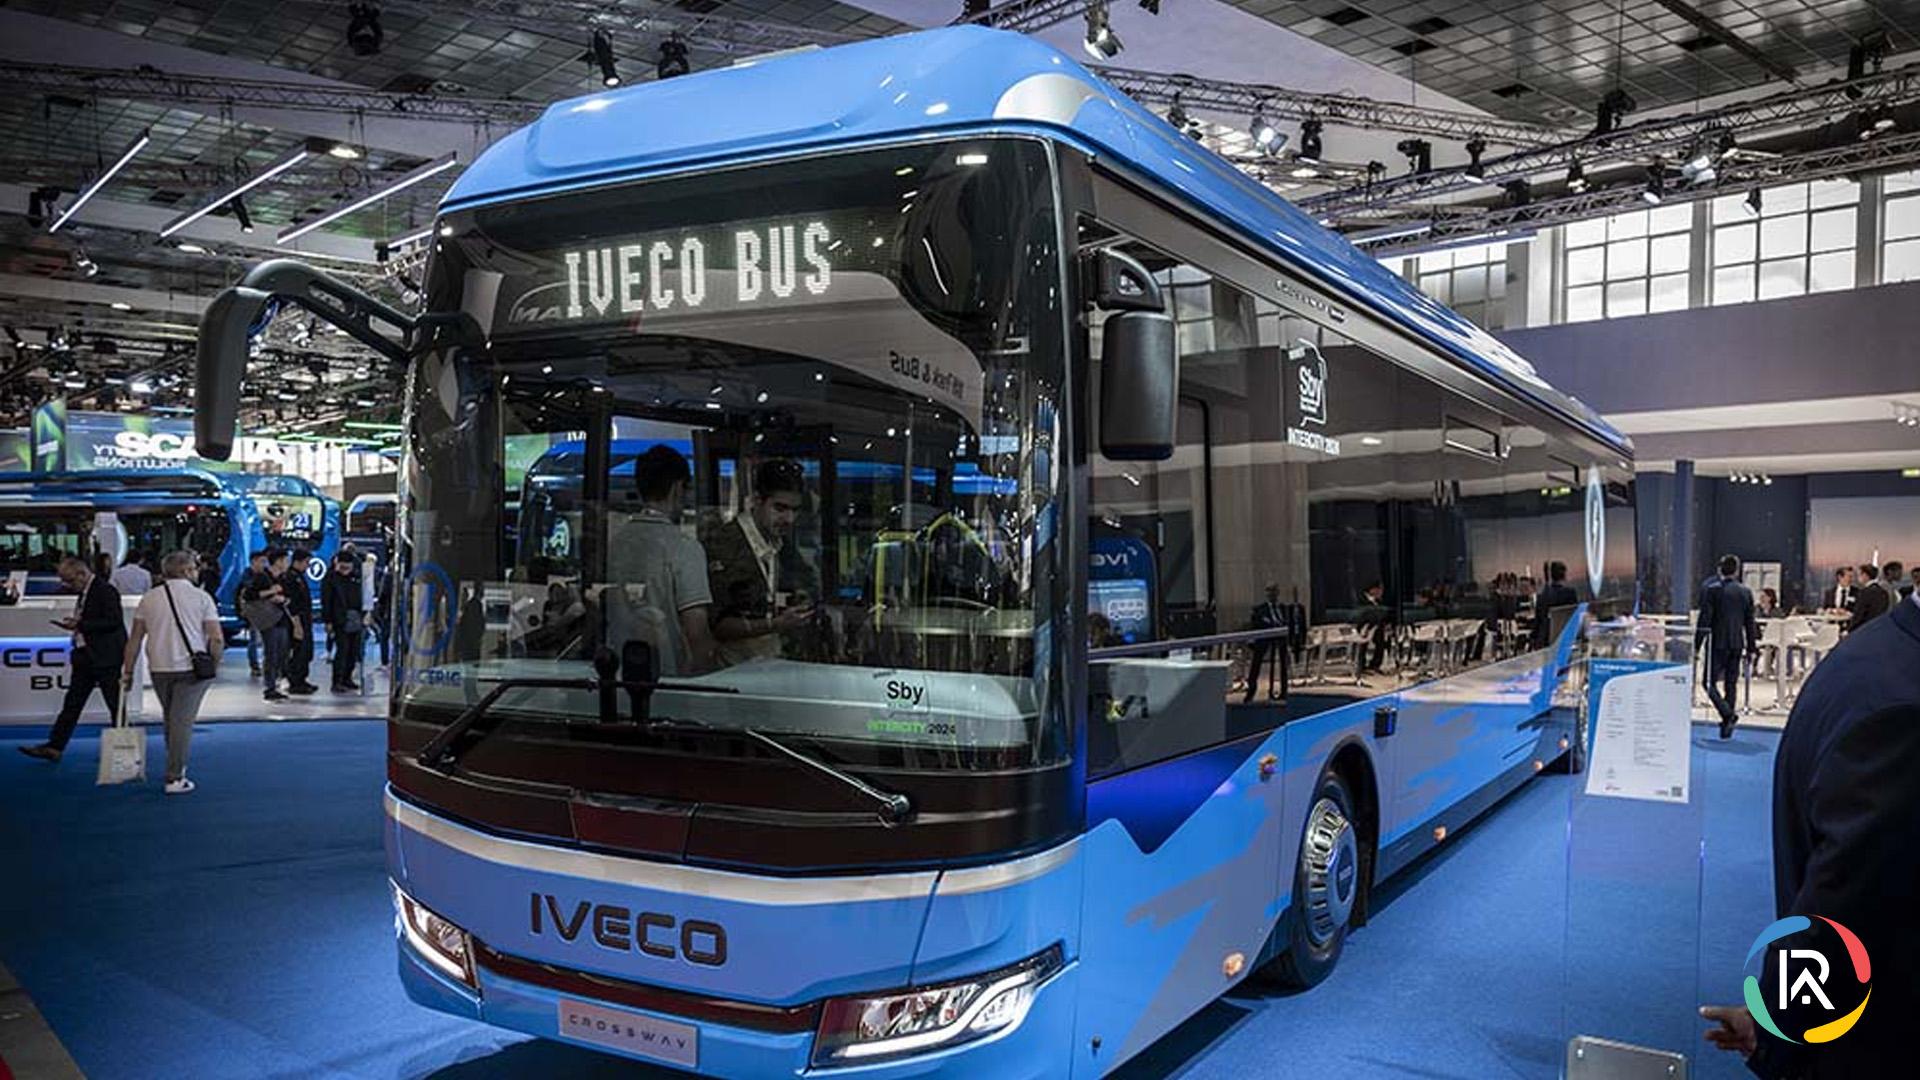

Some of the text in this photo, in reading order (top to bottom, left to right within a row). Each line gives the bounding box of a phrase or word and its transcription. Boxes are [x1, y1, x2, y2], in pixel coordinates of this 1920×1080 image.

[564, 222, 831, 318] IVECO BUS
[887, 681, 924, 705] Sby
[530, 892, 728, 967] IVECO
[569, 1014, 686, 1048] CROSSWAY
